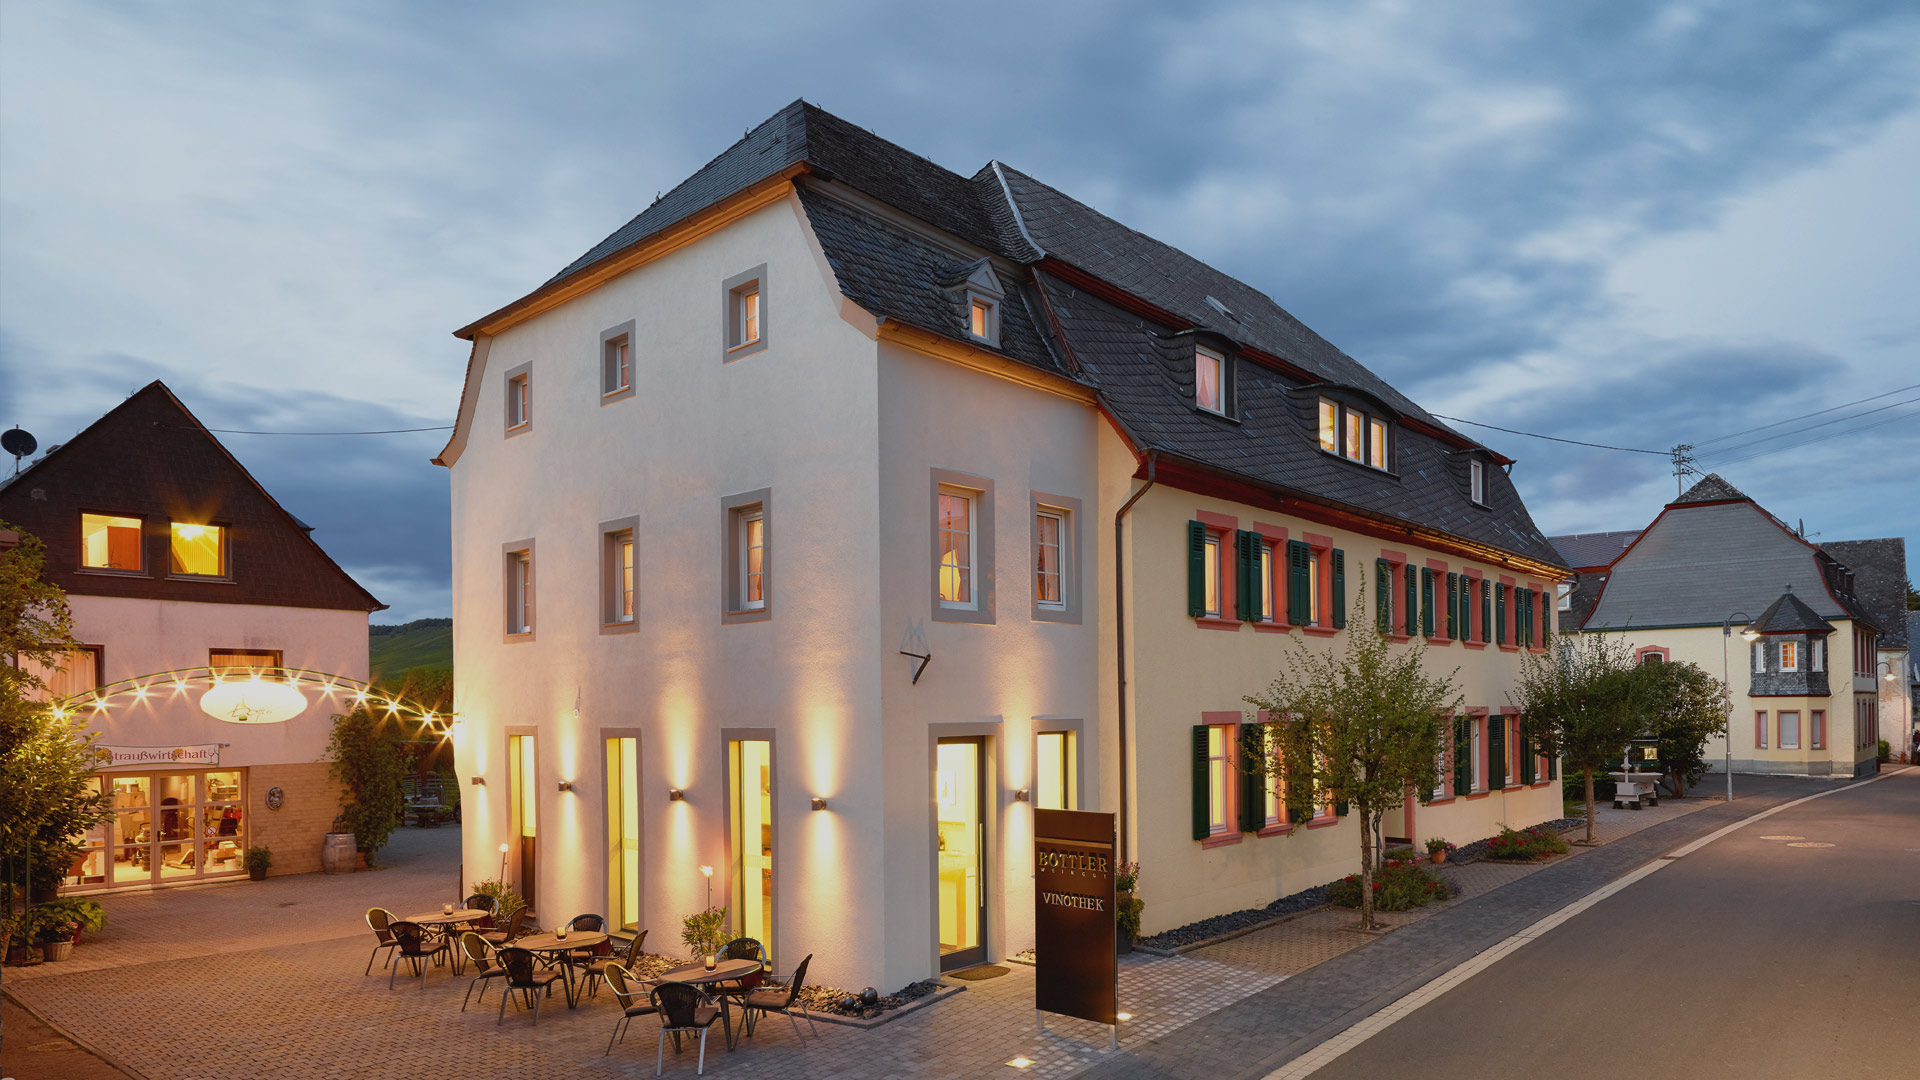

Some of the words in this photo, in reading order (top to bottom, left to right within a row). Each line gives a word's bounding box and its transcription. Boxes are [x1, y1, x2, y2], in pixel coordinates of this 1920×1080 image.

[105, 749, 207, 761] Straußwirtschaft
[1039, 851, 1108, 872] BOTTLER
[1042, 892, 1104, 912] VINOTHEK
